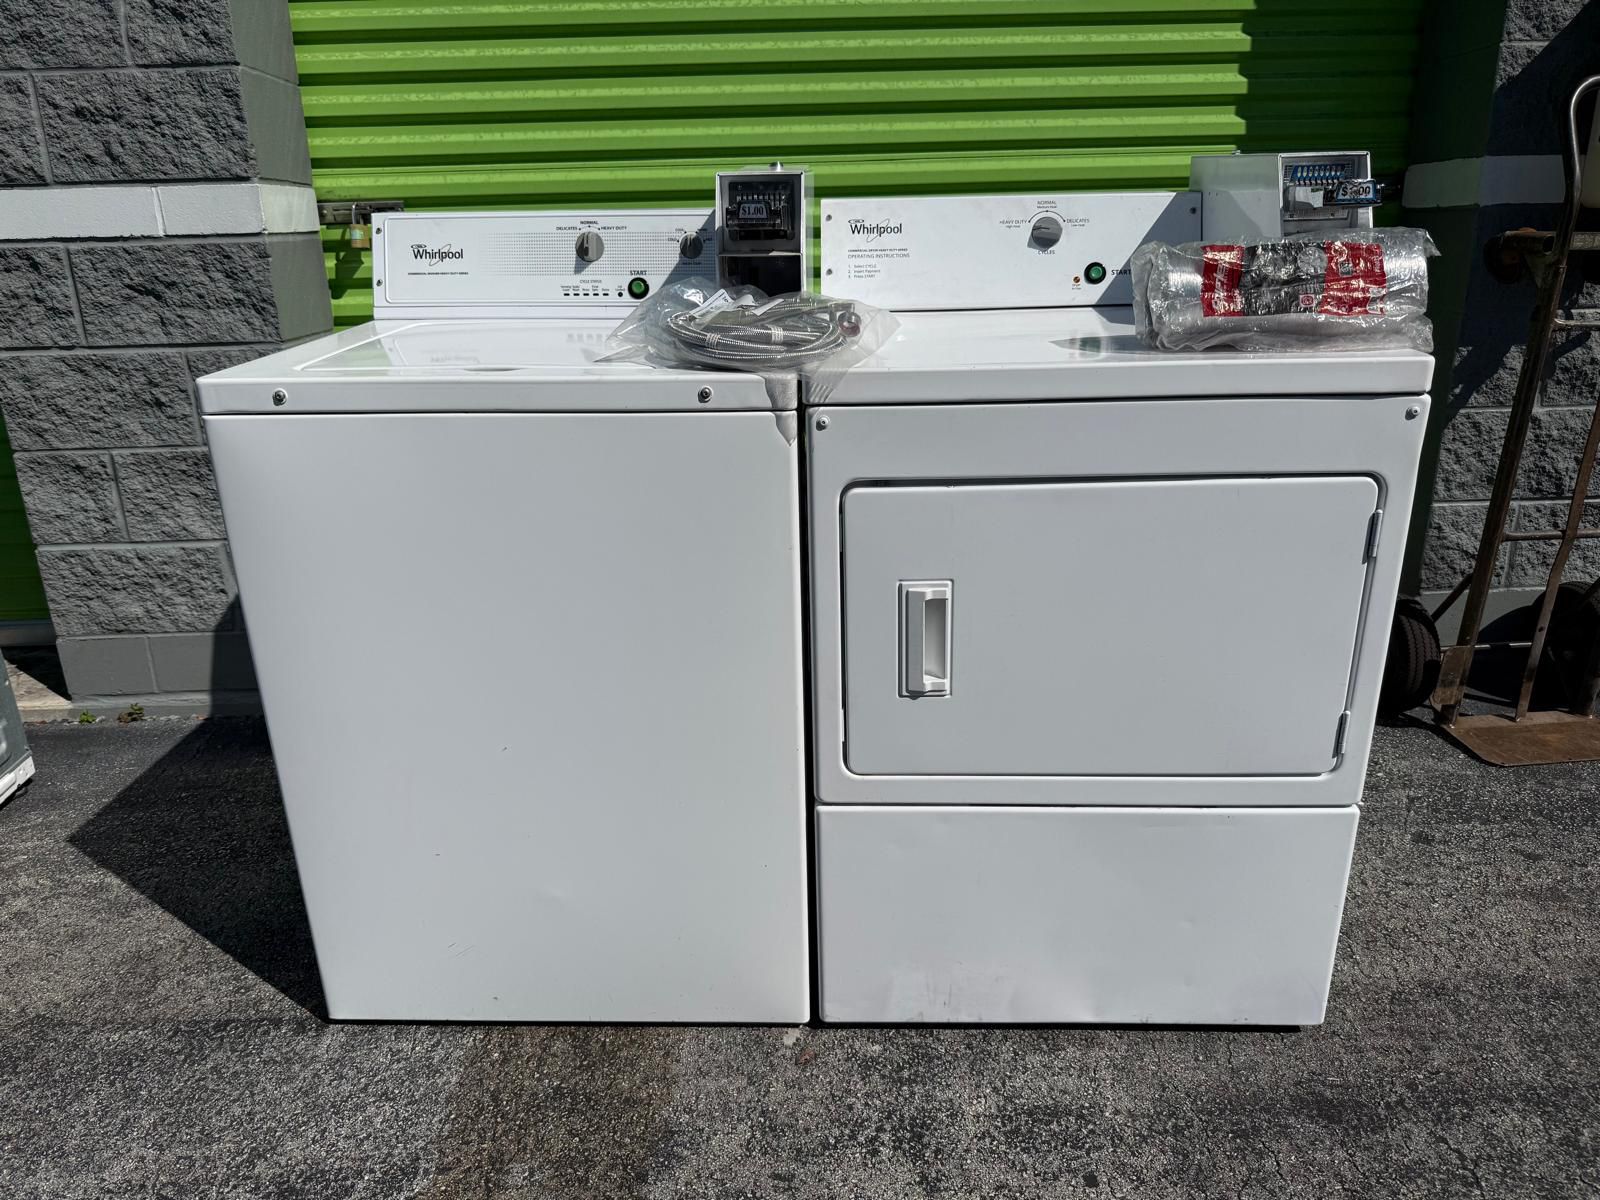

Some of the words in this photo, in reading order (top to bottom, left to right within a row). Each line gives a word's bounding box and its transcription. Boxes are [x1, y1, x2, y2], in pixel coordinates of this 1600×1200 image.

[741, 205, 764, 216] $1.00
[849, 222, 903, 238] Whirlpool
[412, 247, 464, 263] Whirlpool
